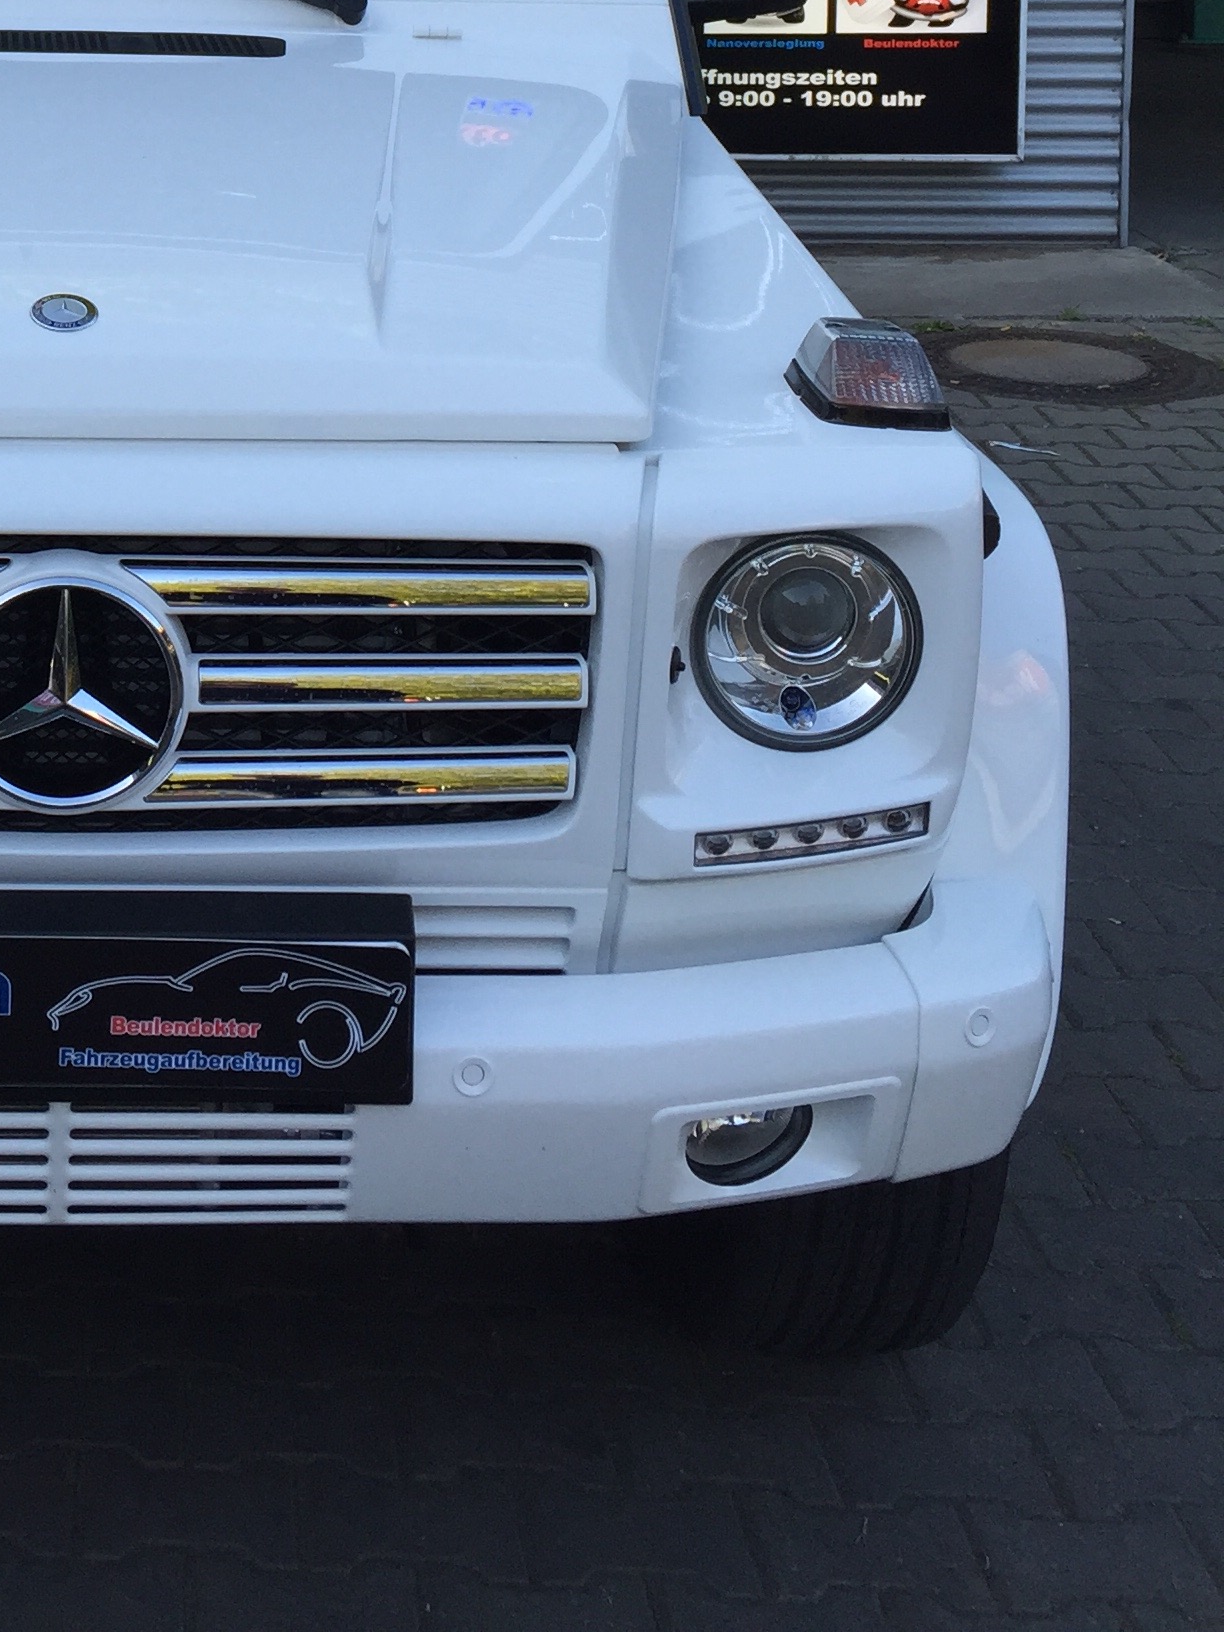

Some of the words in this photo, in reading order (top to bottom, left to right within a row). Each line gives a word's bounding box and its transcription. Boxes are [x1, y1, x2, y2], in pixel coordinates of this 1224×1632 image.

[707, 38, 825, 49] Nanoversieglung
[864, 38, 960, 49] Beulendoktor
[701, 69, 878, 89] ffnungszeiten
[718, 90, 775, 107] 9:00
[800, 90, 873, 107] 19:00
[881, 90, 926, 107] uhr
[110, 1015, 262, 1039] Beulendoktor
[58, 1046, 303, 1078] Fahrzeugaufbereitung
